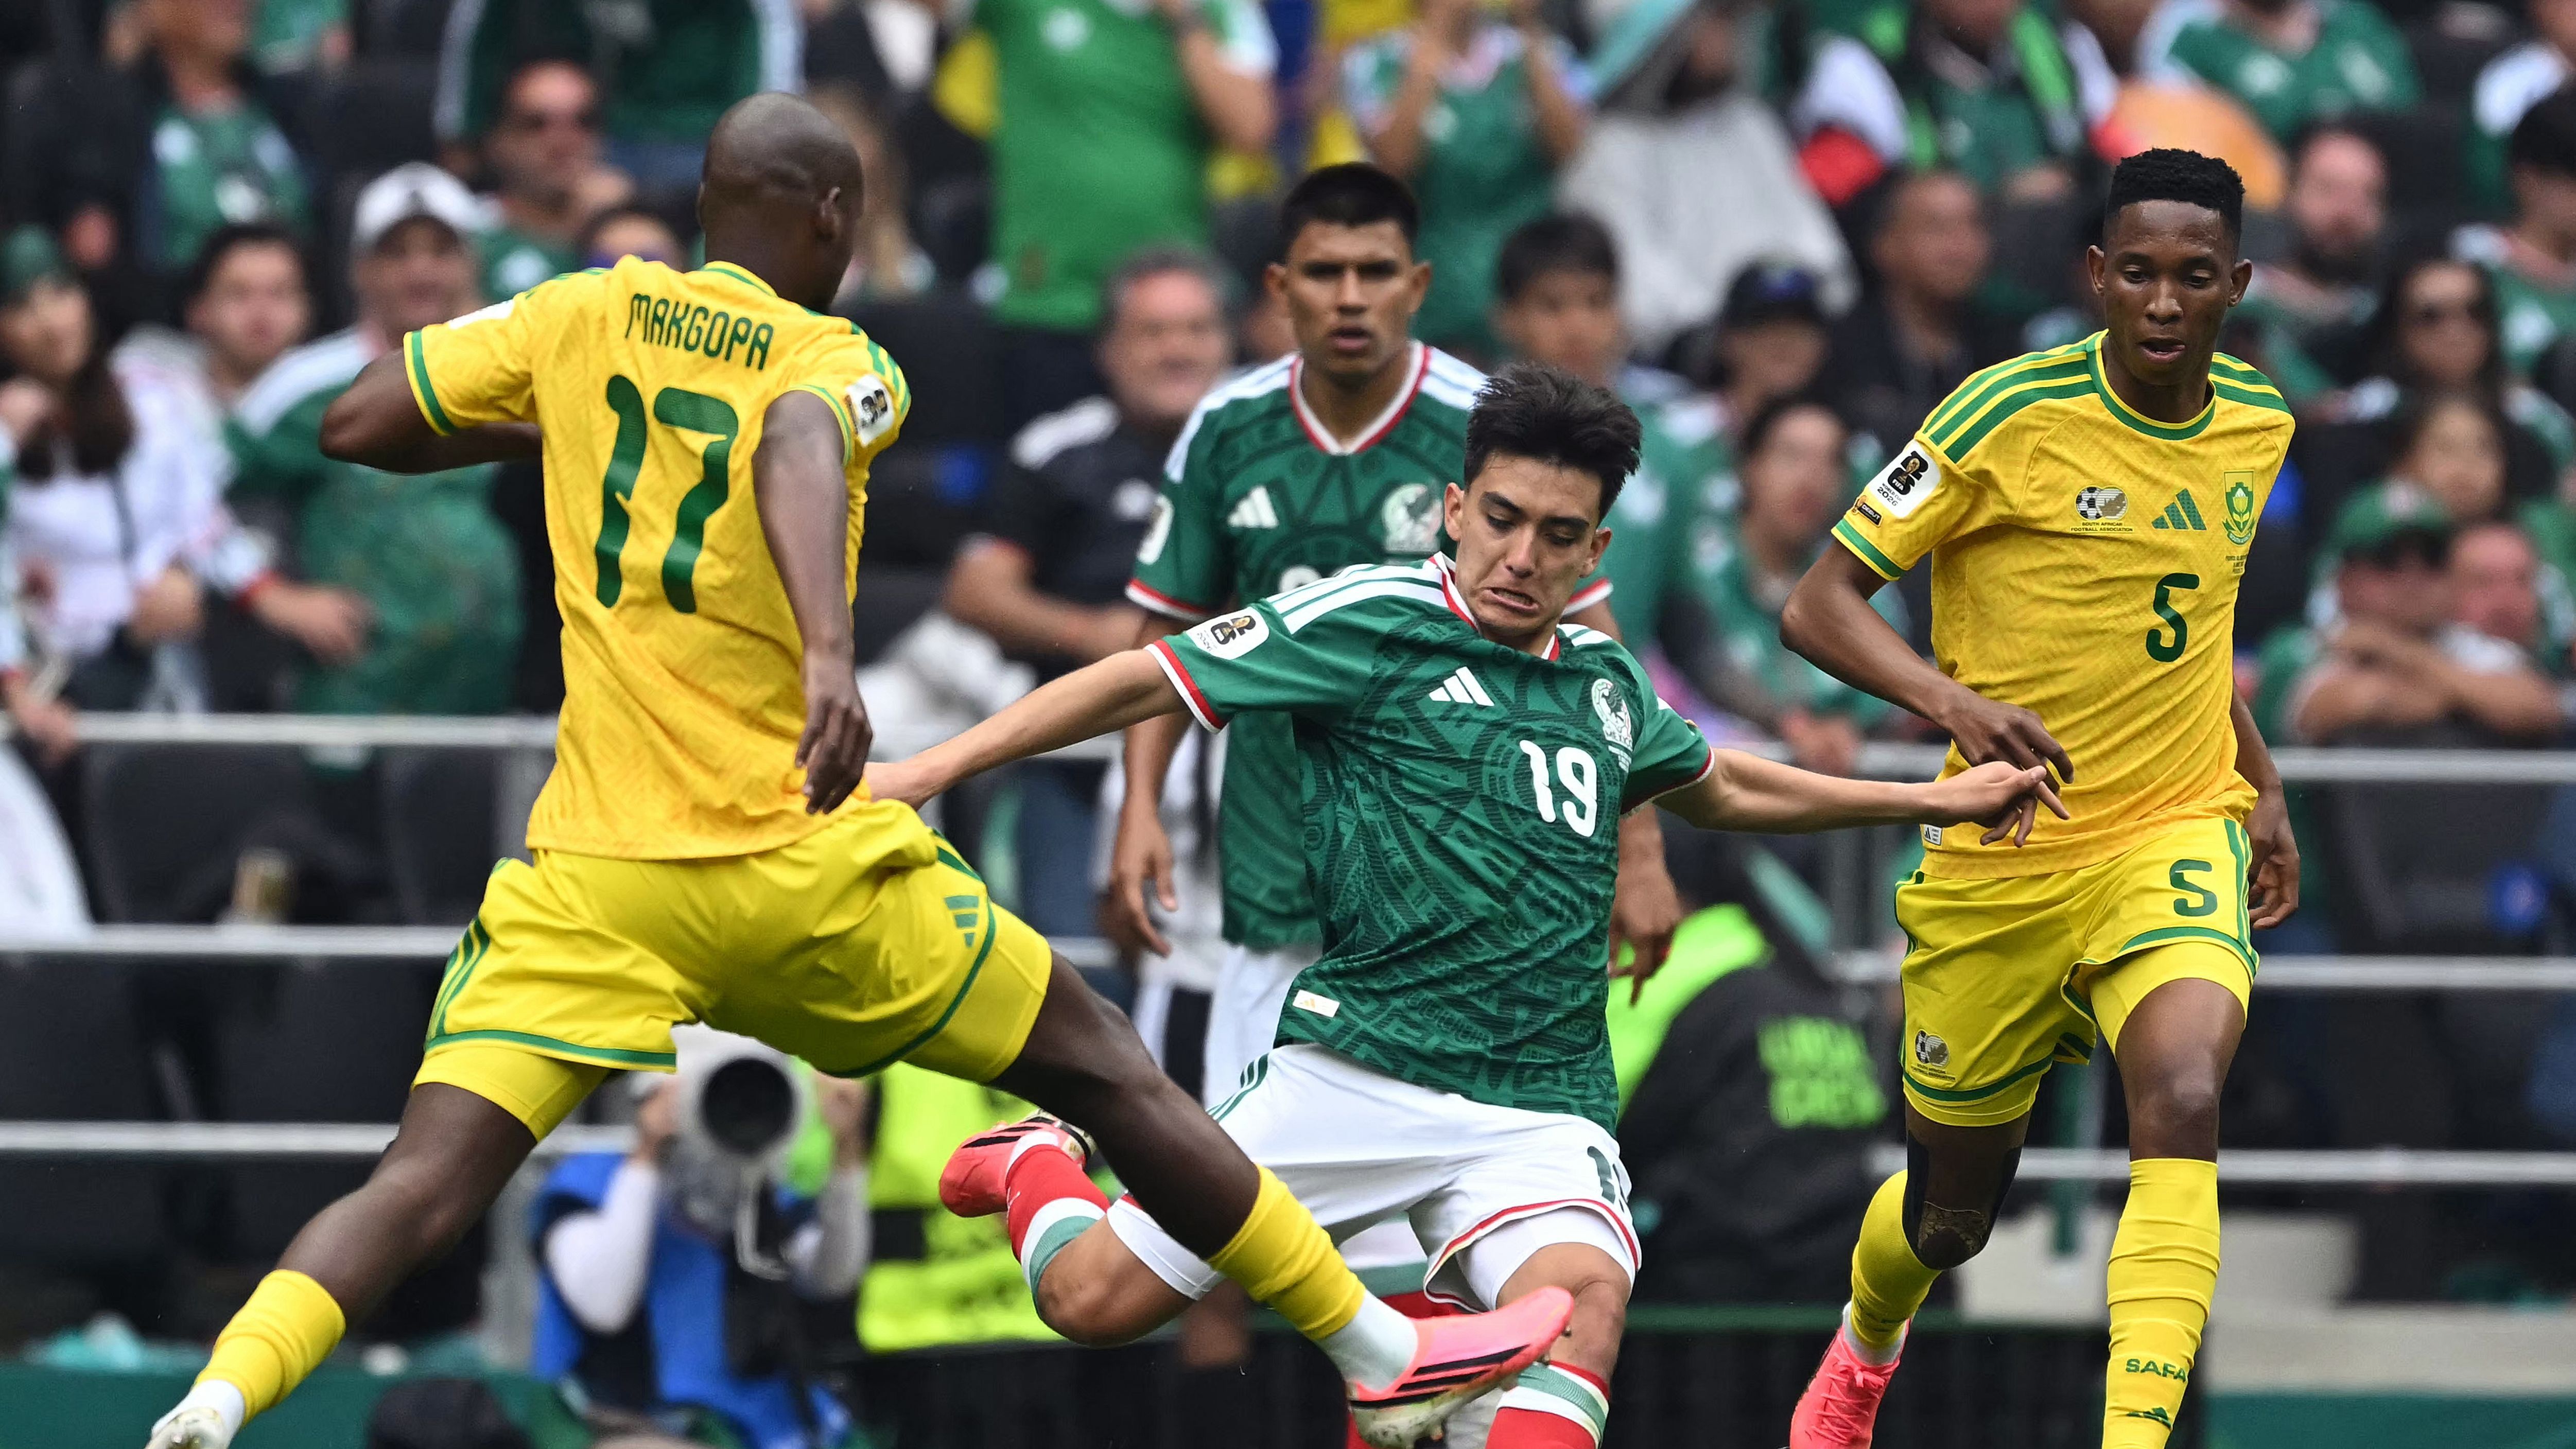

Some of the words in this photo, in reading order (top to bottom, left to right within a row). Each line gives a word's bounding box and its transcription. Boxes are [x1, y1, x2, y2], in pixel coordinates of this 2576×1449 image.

[624, 292, 774, 371] MAKGOPA
[596, 374, 739, 614] 17
[1861, 504, 1880, 520] DEBUT
[1877, 486, 1899, 507] 2026
[2146, 572, 2200, 663] 5
[1519, 739, 1597, 837] 19
[2169, 859, 2218, 917] 5
[2126, 1358, 2186, 1383] SAFA
